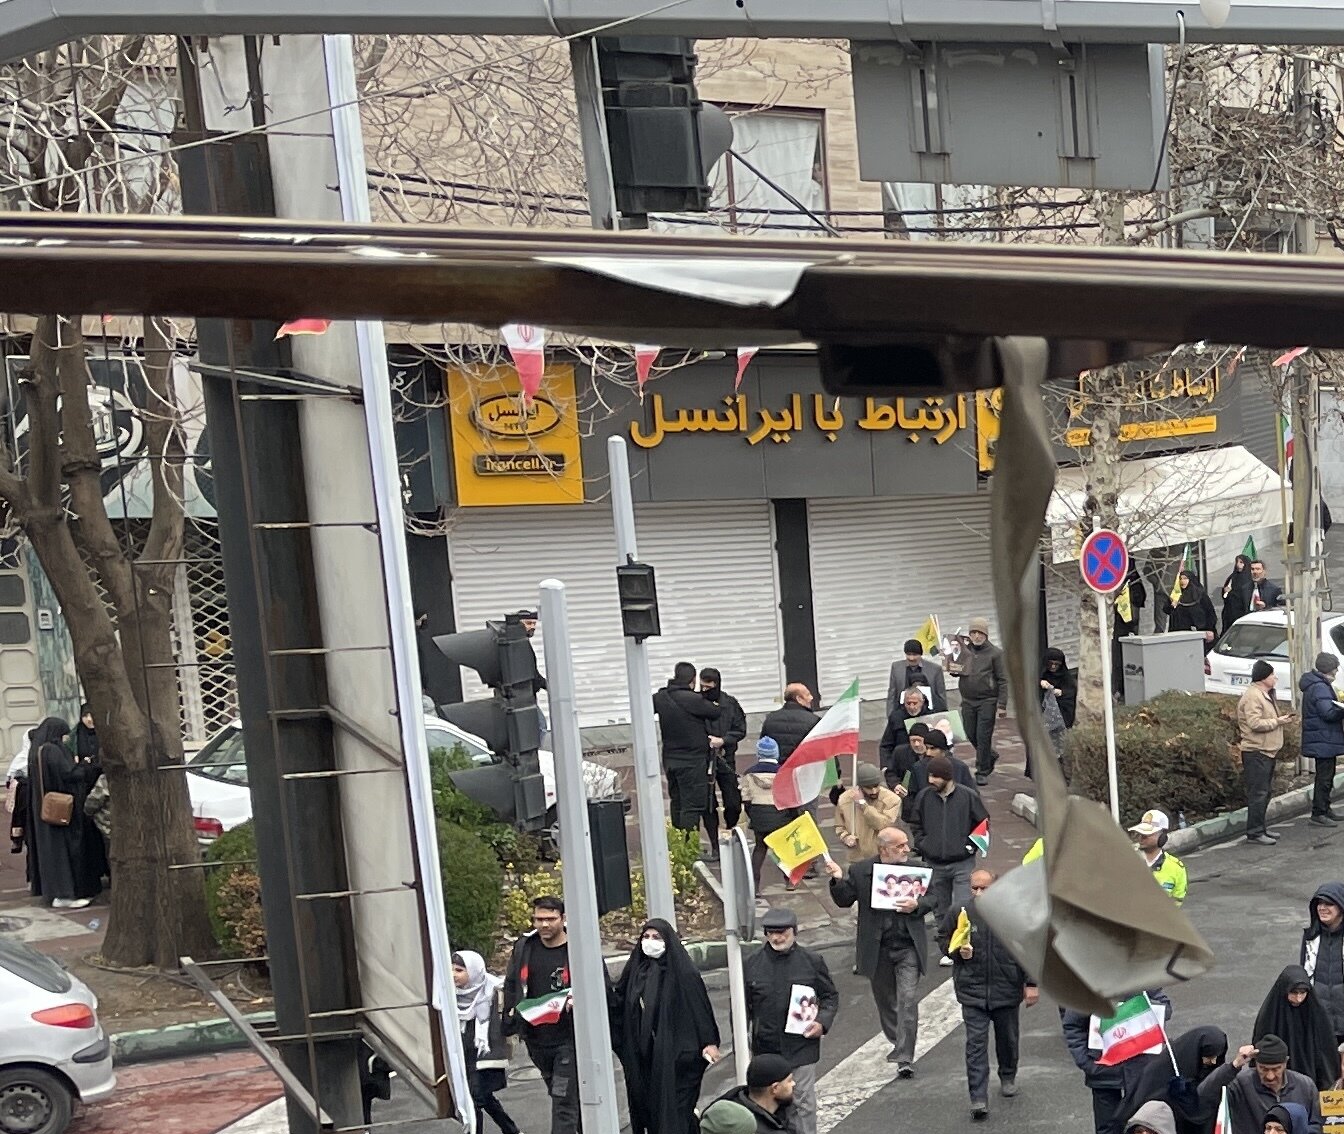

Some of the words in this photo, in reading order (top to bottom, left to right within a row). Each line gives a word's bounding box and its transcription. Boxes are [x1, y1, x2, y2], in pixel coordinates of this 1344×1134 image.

[629, 392, 802, 448] ایرانسل
[811, 393, 844, 442] با
[858, 394, 967, 444] ارتباط
